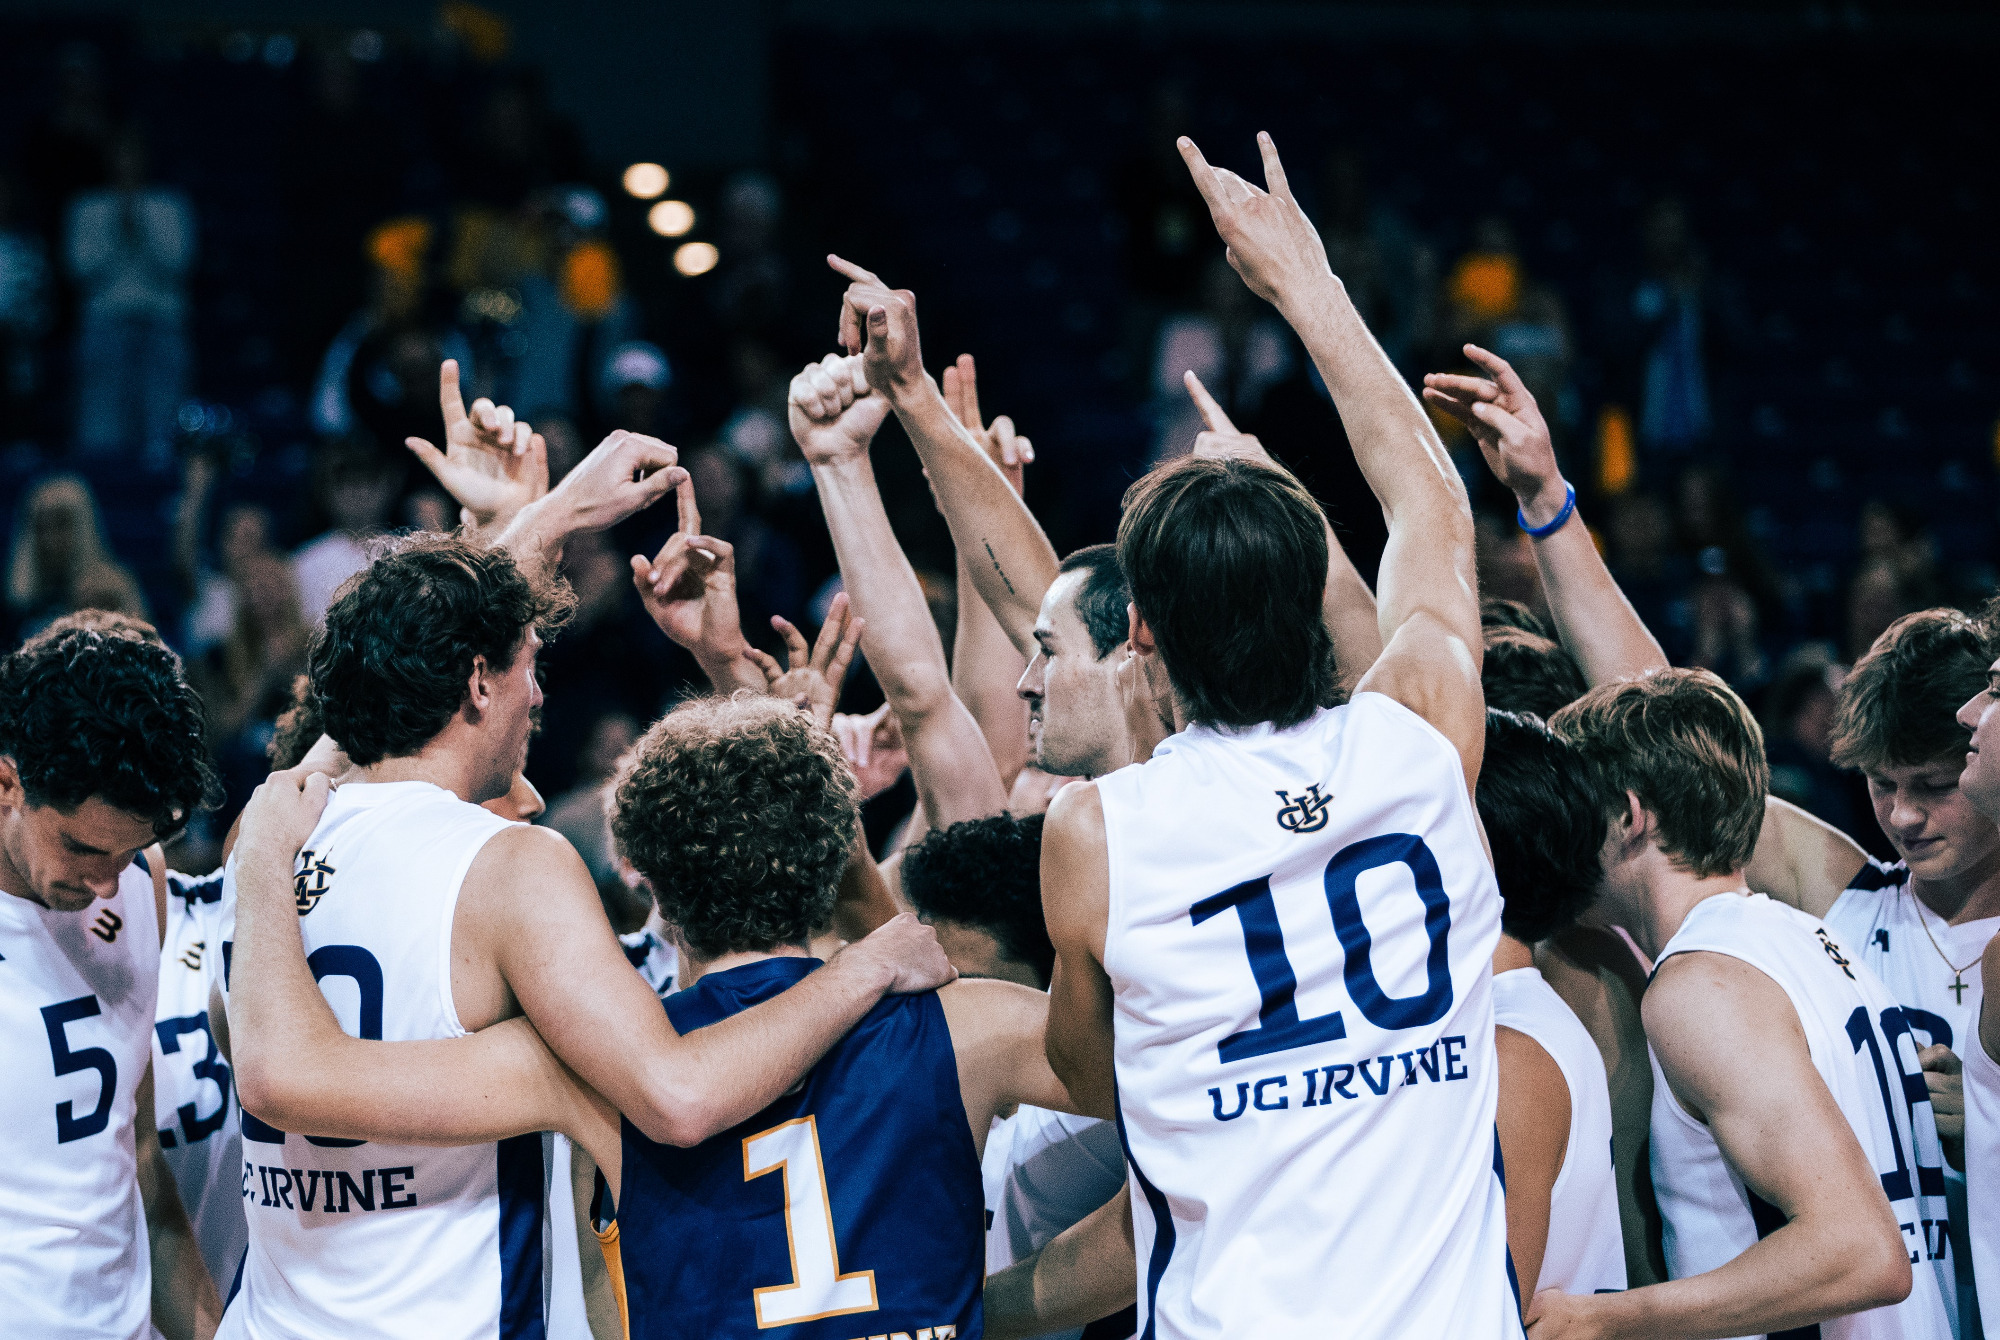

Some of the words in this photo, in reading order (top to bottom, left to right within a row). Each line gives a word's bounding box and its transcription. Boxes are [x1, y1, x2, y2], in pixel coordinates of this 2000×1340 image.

[1189, 832, 1454, 1064] 10
[40, 994, 117, 1144] 5
[1207, 1074, 1289, 1122] UC
[1302, 1035, 1468, 1108] IRVINE
[258, 1165, 418, 1213] IRVINE
[741, 1113, 880, 1330] 1
